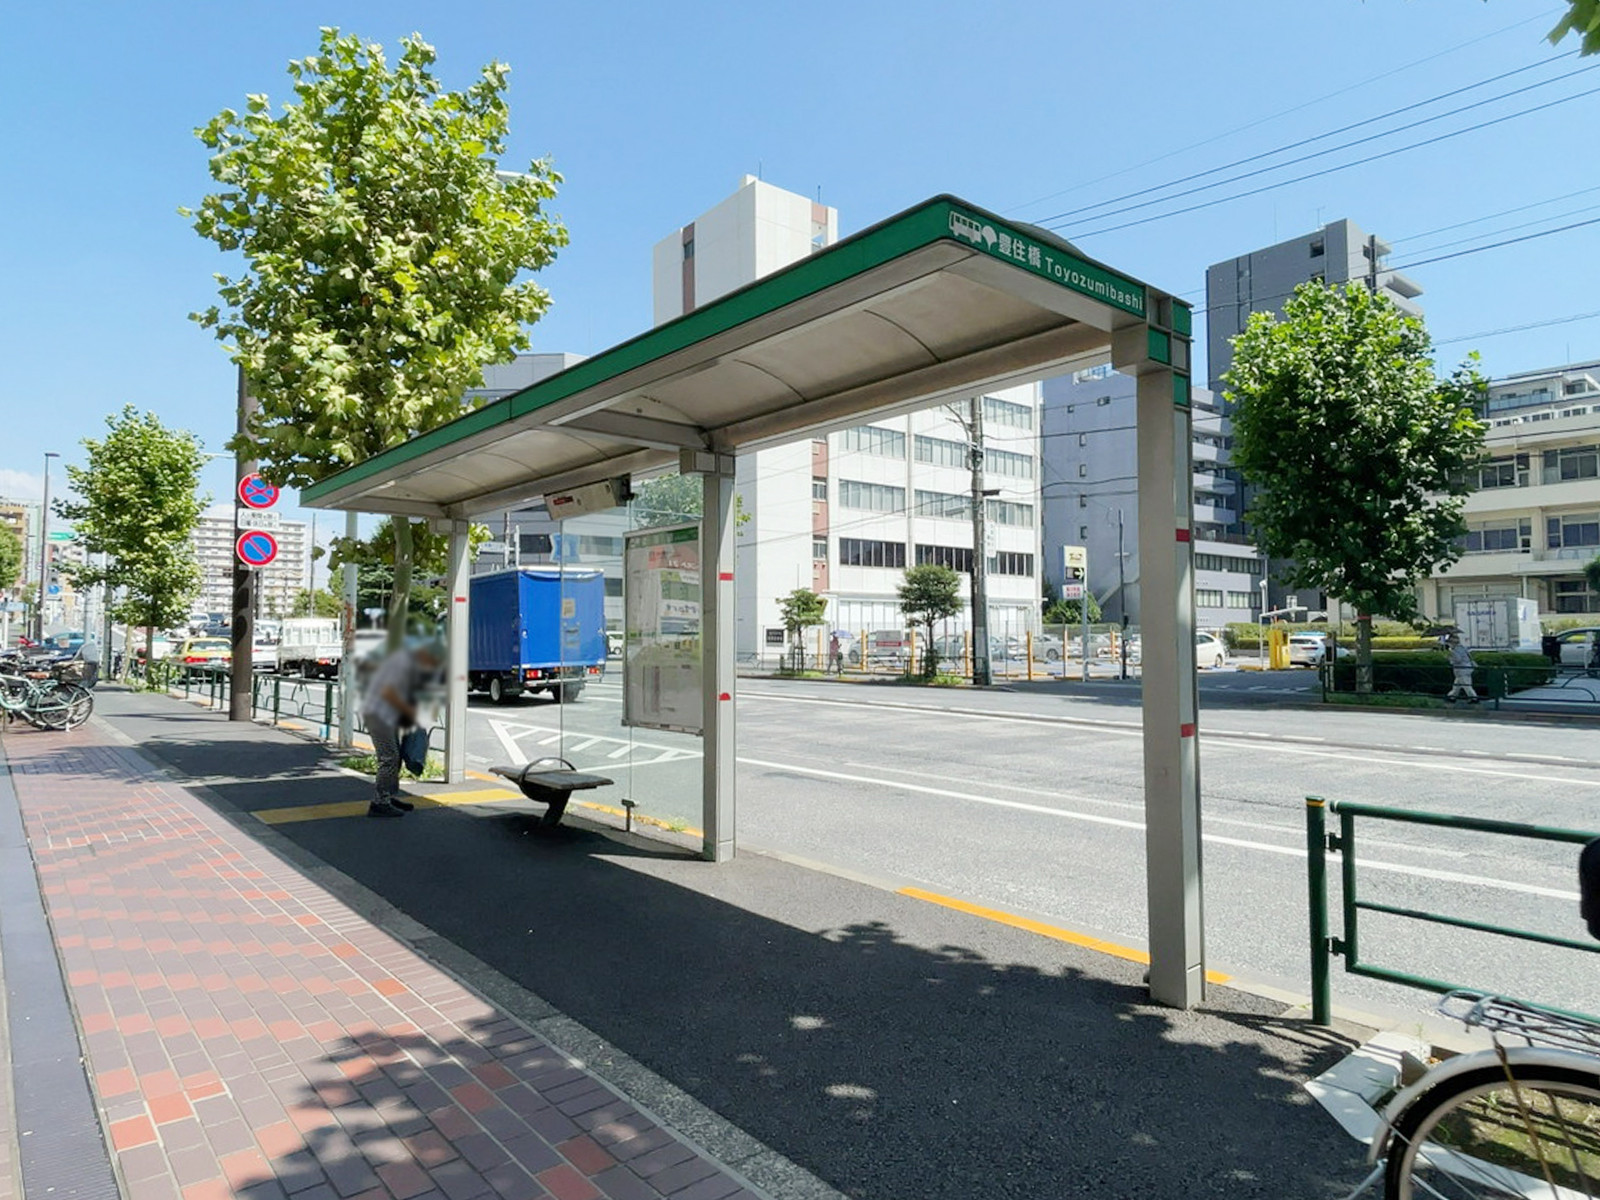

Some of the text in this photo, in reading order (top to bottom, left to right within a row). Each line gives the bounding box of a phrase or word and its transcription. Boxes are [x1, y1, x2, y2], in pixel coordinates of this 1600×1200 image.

[999, 232, 1143, 311] 豊住橋 Toyozumibashi
